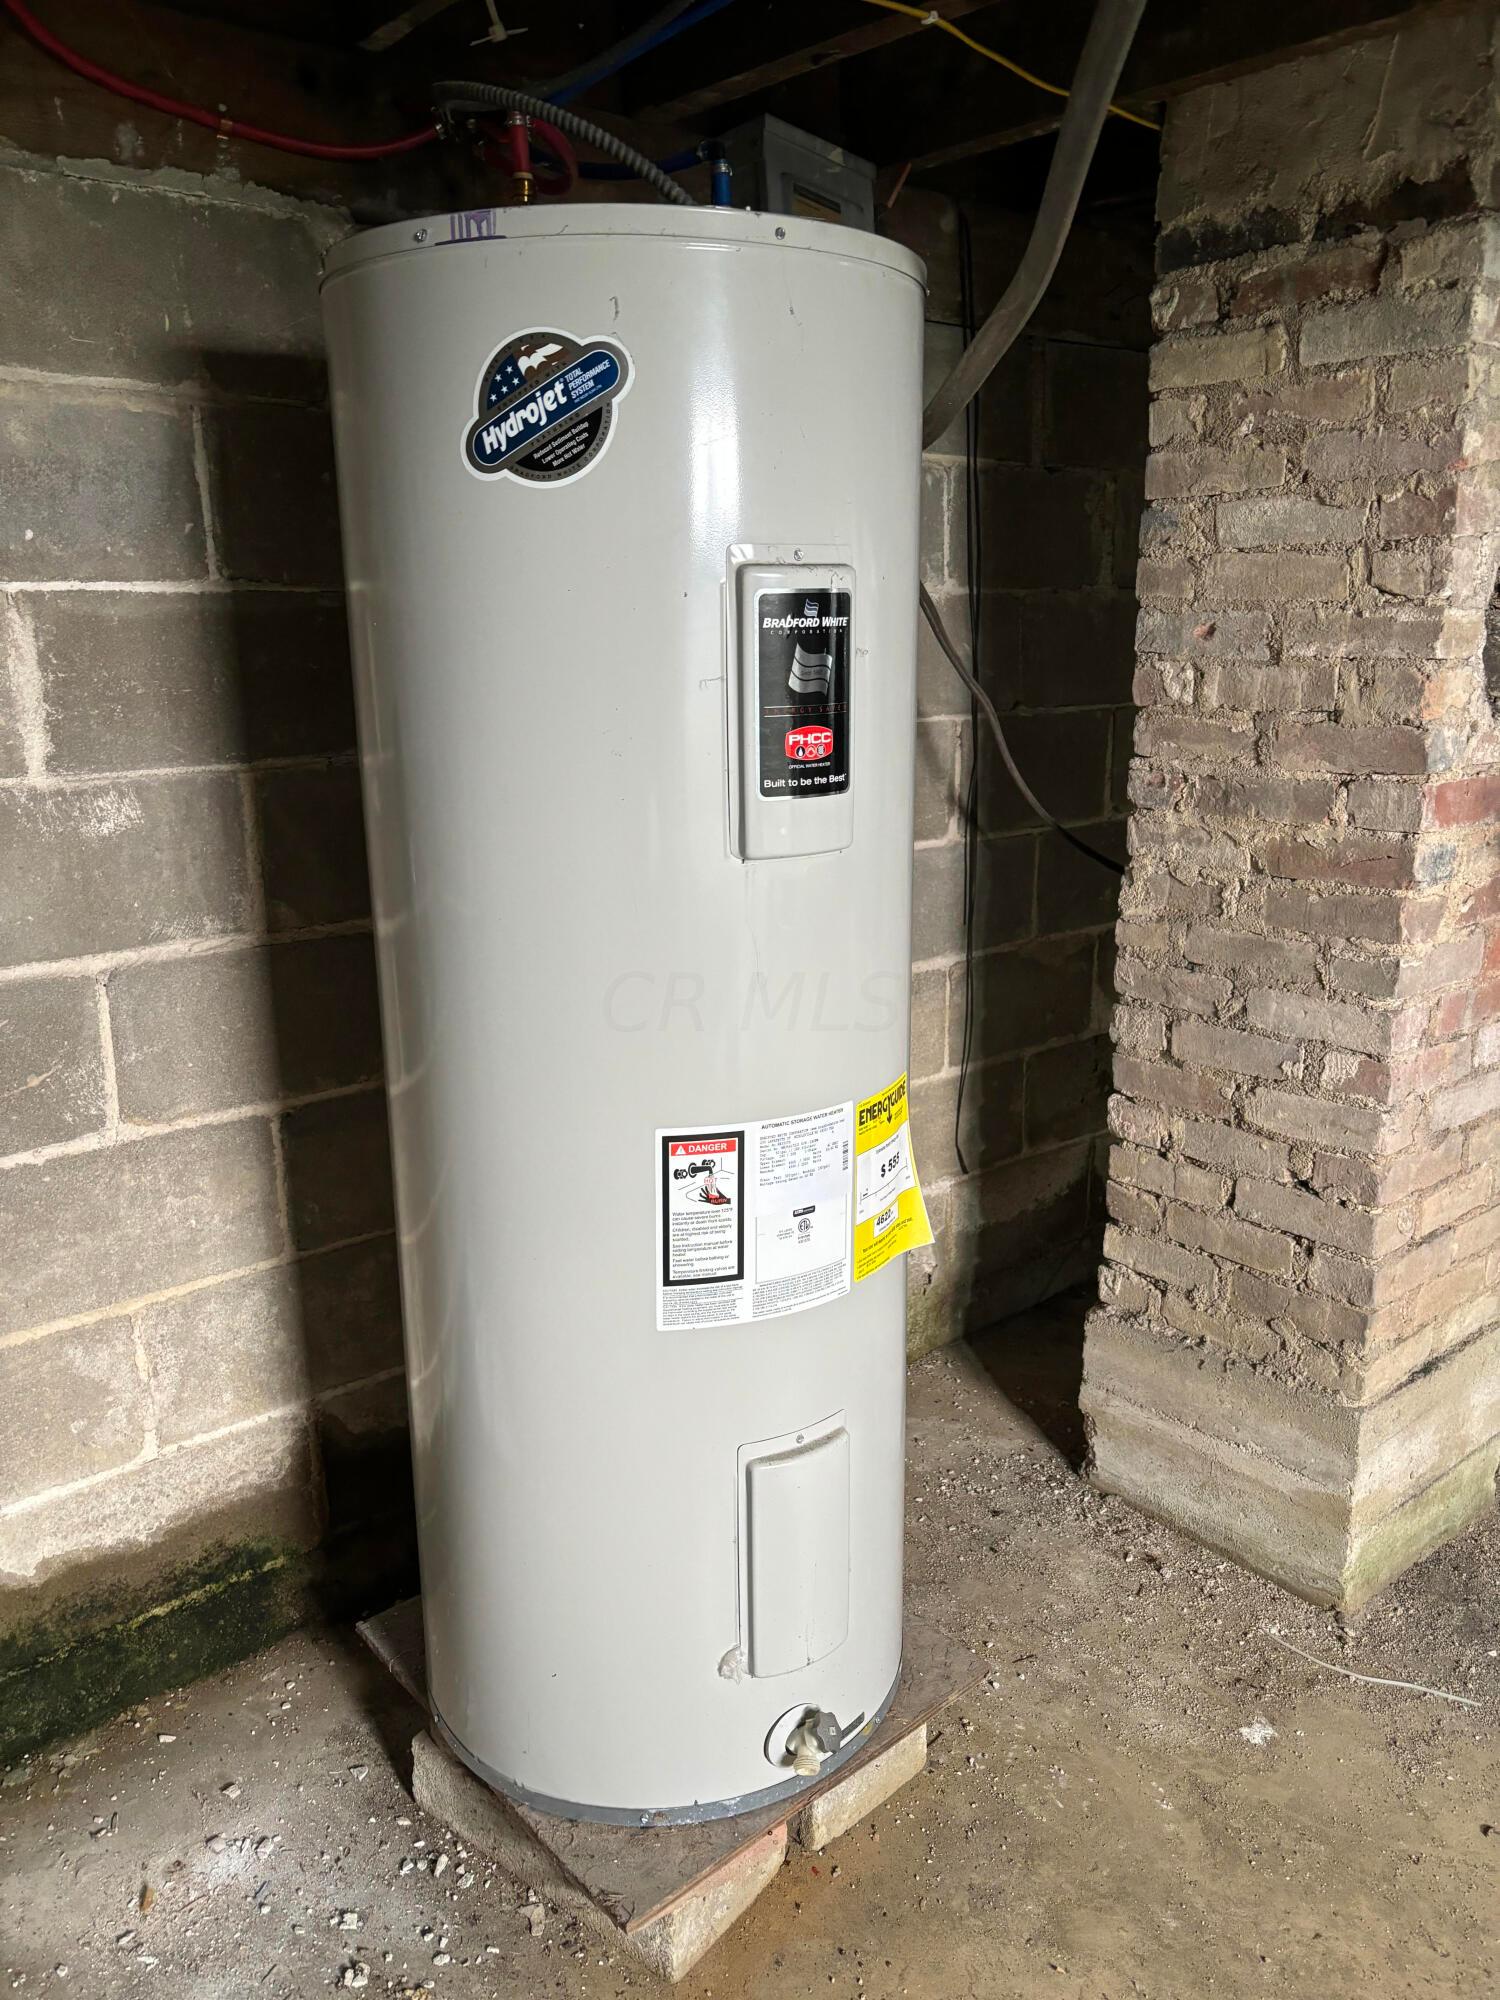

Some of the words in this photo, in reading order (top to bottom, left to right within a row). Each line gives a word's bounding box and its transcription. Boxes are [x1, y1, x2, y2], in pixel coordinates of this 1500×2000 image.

[565, 367, 584, 382] TOTAL
[568, 359, 611, 391] PERFORMANCE
[571, 380, 595, 400] SYSTEM
[482, 380, 568, 456] Hydrojet
[541, 452, 556, 464] Lower
[762, 614, 820, 628] BRADFORD
[822, 616, 849, 627] WHITE
[788, 732, 831, 746] PHCC
[764, 779, 786, 788] Built
[829, 774, 845, 783] Best
[688, 1143, 727, 1153] DANGER
[881, 1164, 886, 1178] $
[888, 1152, 900, 1172] 555
